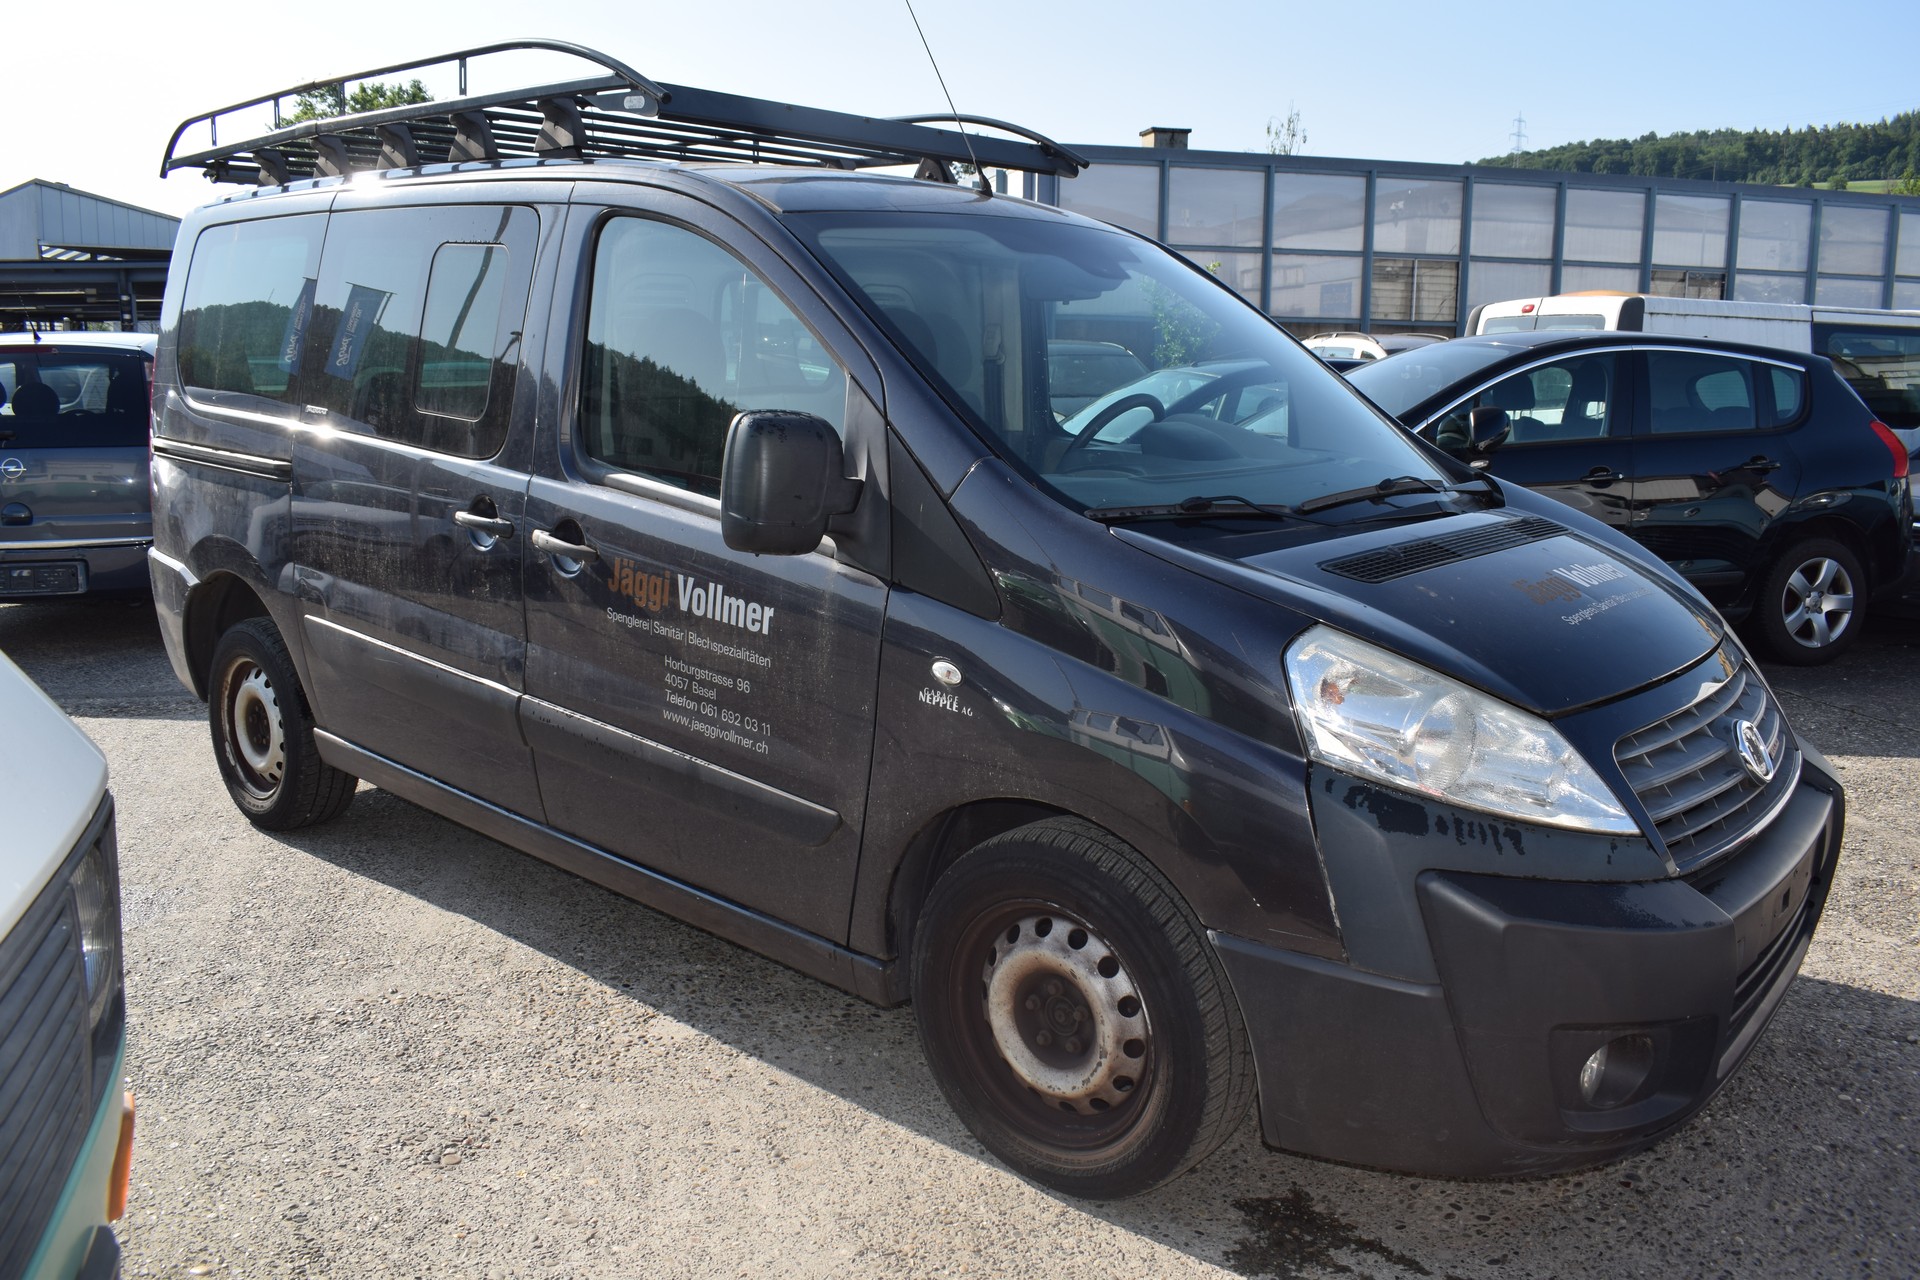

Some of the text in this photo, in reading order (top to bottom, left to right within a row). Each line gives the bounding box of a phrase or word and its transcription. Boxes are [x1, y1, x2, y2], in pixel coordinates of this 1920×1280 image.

[607, 557, 775, 635] Jäggi Vollmer
[1552, 563, 1628, 588] Vollmer
[606, 607, 771, 668] Spenglerei Sanitär Blechspezialitäten
[664, 654, 751, 694] Horburgstrasse 96
[664, 673, 717, 700] 4057 Basel
[665, 689, 771, 736] Telefon 061 692 03 11
[919, 690, 973, 717] NEPPLE AG
[663, 709, 769, 755] www.jaeggivollmer.ch
